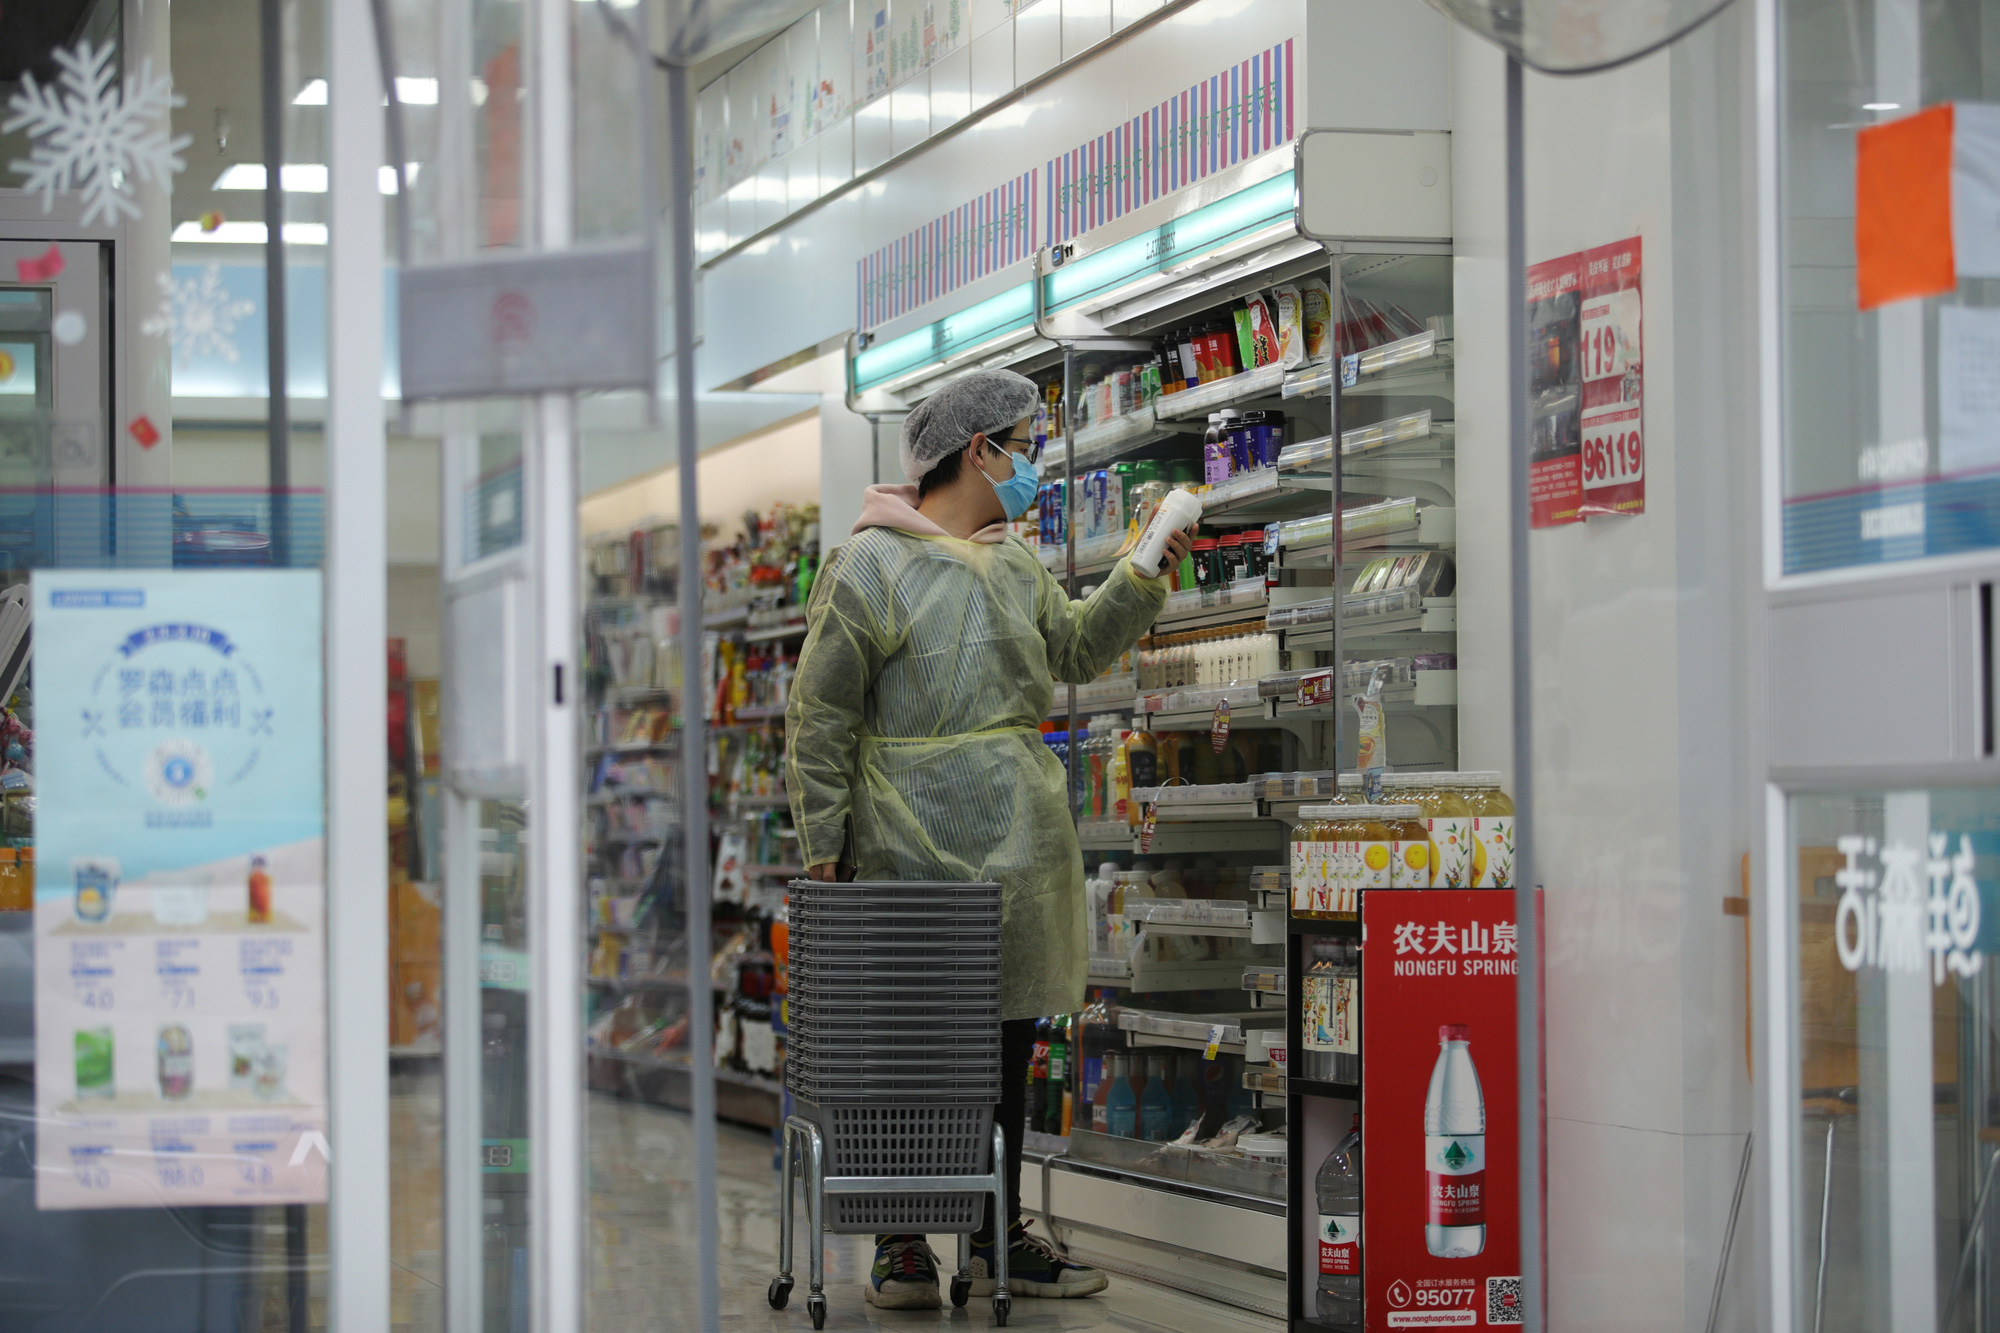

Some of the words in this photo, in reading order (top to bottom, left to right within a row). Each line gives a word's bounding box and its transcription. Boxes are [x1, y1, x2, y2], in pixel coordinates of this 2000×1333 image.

[1145, 231, 1175, 260] LAWSON
[1581, 325, 1615, 377] 119
[1583, 430, 1641, 482] 96119
[1393, 921, 1519, 955] 农夫山泉
[1394, 960, 1457, 976] NONGFU
[1463, 959, 1519, 975] SPRING
[1432, 1184, 1480, 1198] 农夫山泉
[1321, 1247, 1350, 1258] 农夫山泉
[1416, 1279, 1475, 1287] 全国订水服务热线
[1415, 1289, 1475, 1306] 95077
[1392, 1314, 1472, 1324] www.nongfuspring.com
